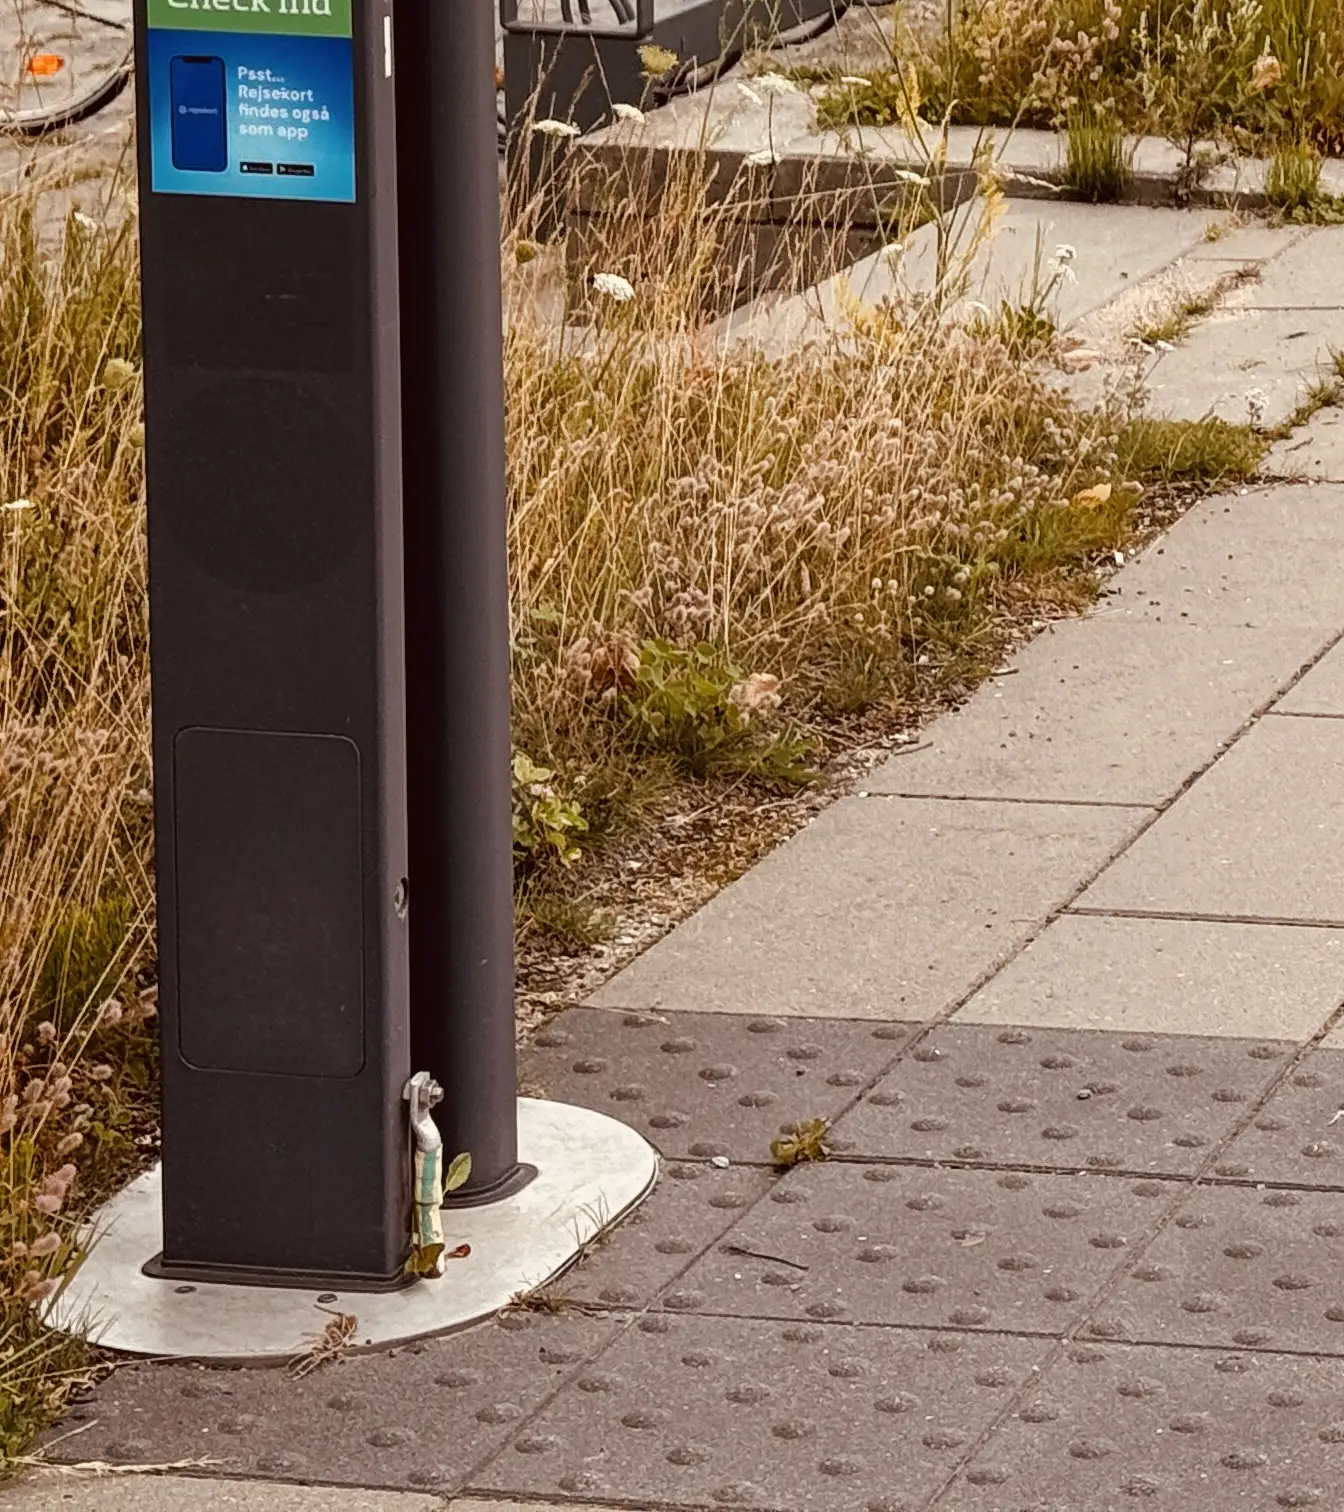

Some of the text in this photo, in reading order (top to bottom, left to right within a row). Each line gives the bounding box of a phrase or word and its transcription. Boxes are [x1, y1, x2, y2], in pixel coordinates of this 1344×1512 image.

[238, 84, 314, 103] Rejsekort
[239, 103, 330, 123] findes også
[239, 122, 309, 141] som app
